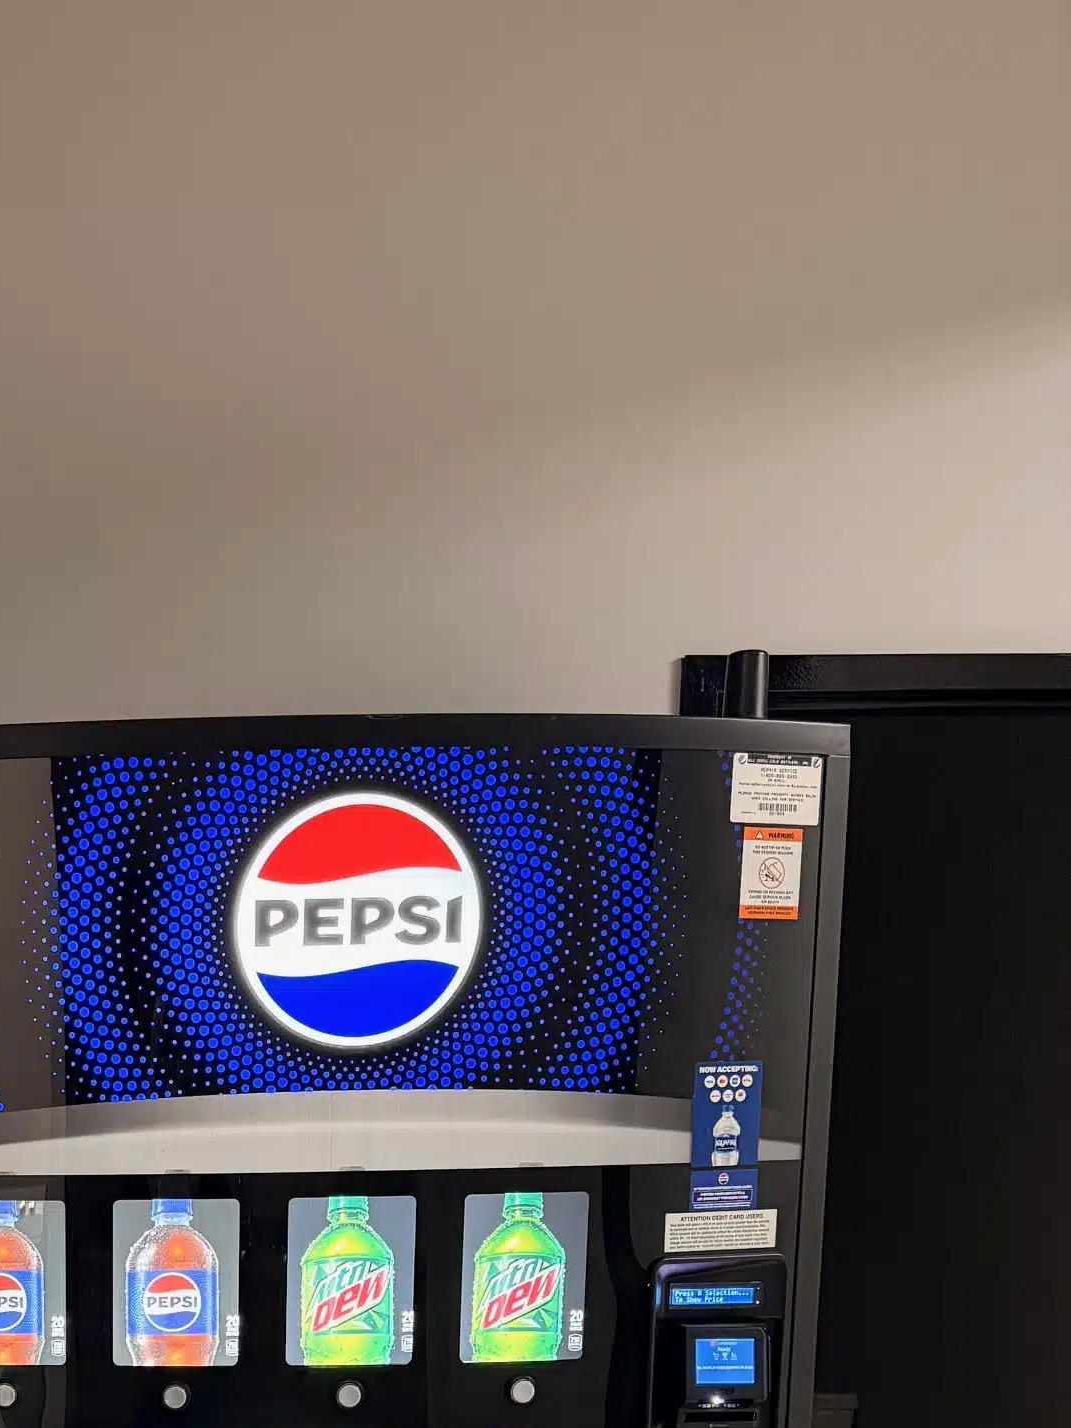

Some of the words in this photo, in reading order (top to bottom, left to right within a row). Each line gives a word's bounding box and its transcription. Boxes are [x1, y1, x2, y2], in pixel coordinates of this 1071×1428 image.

[254, 895, 463, 947] PEPSI
[699, 1066, 716, 1074] NOW
[674, 1289, 694, 1297] Press
[146, 1295, 198, 1308] PEPSI
[51, 1315, 65, 1328] 20
[225, 1314, 240, 1327] 20
[569, 1309, 583, 1322] 20
